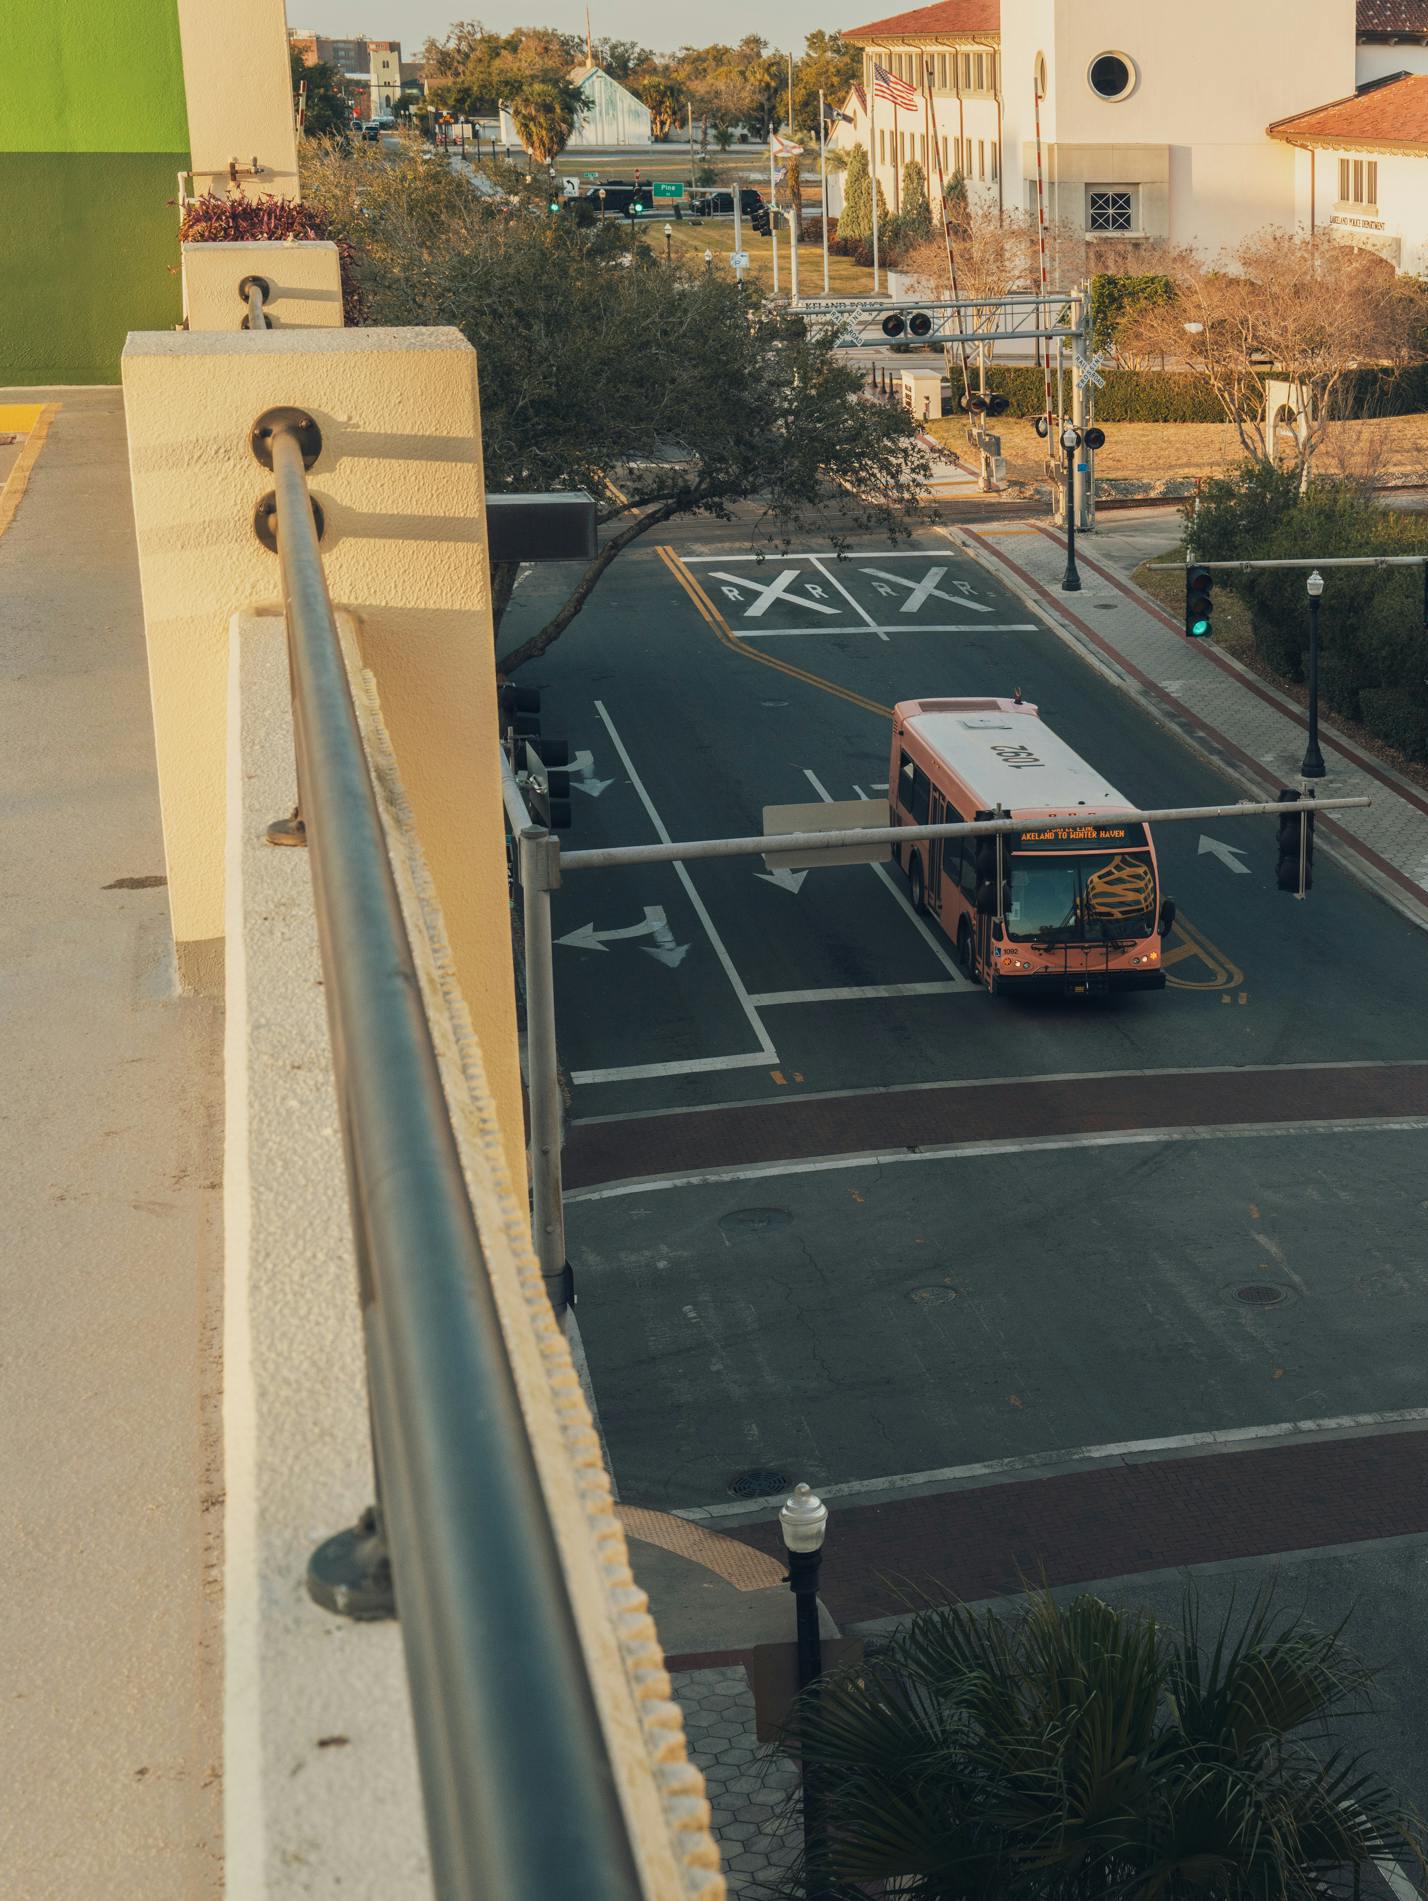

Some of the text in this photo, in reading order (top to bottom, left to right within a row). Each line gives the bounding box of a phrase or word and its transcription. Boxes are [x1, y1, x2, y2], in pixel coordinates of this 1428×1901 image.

[990, 745, 1045, 769] 1092
[1058, 831, 1067, 839] TO
[1070, 830, 1097, 839] WINTER
[1099, 830, 1125, 838] HAVEN
